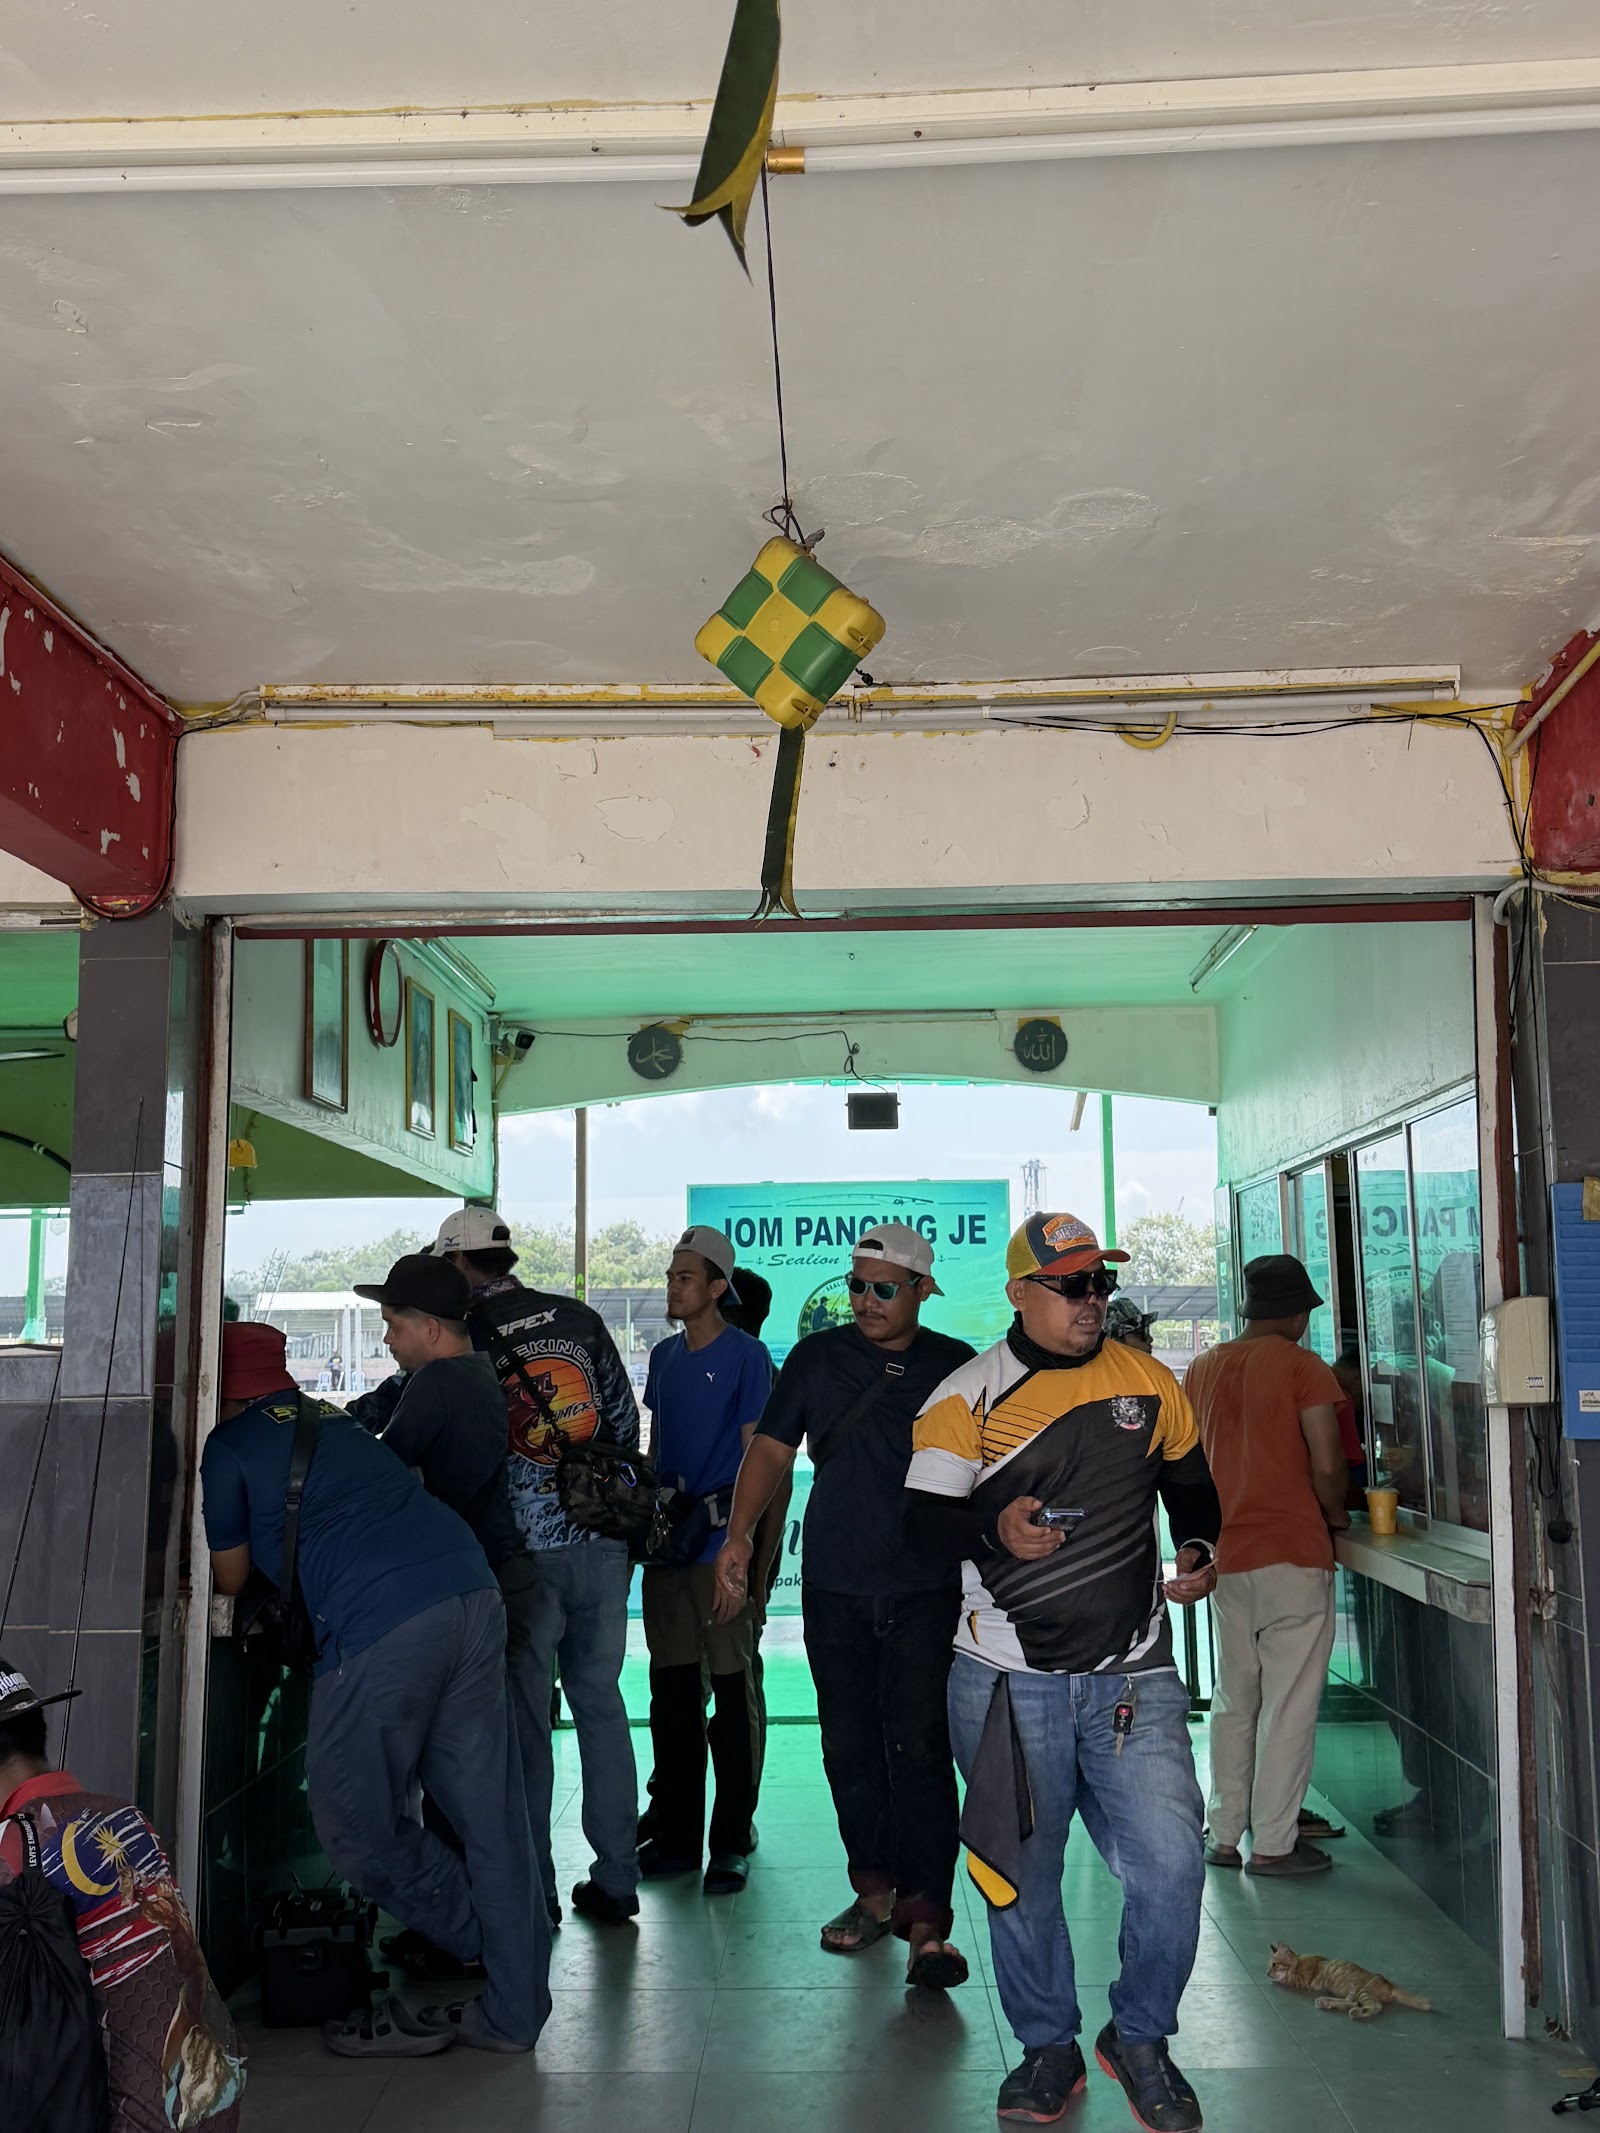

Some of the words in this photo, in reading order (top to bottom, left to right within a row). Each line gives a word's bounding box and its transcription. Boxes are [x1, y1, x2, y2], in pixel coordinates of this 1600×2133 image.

[948, 1214, 986, 1245] JE
[767, 1253, 840, 1266] Sealion
[497, 1308, 558, 1337] APEX
[29, 1845, 37, 1867] LEVI'S
